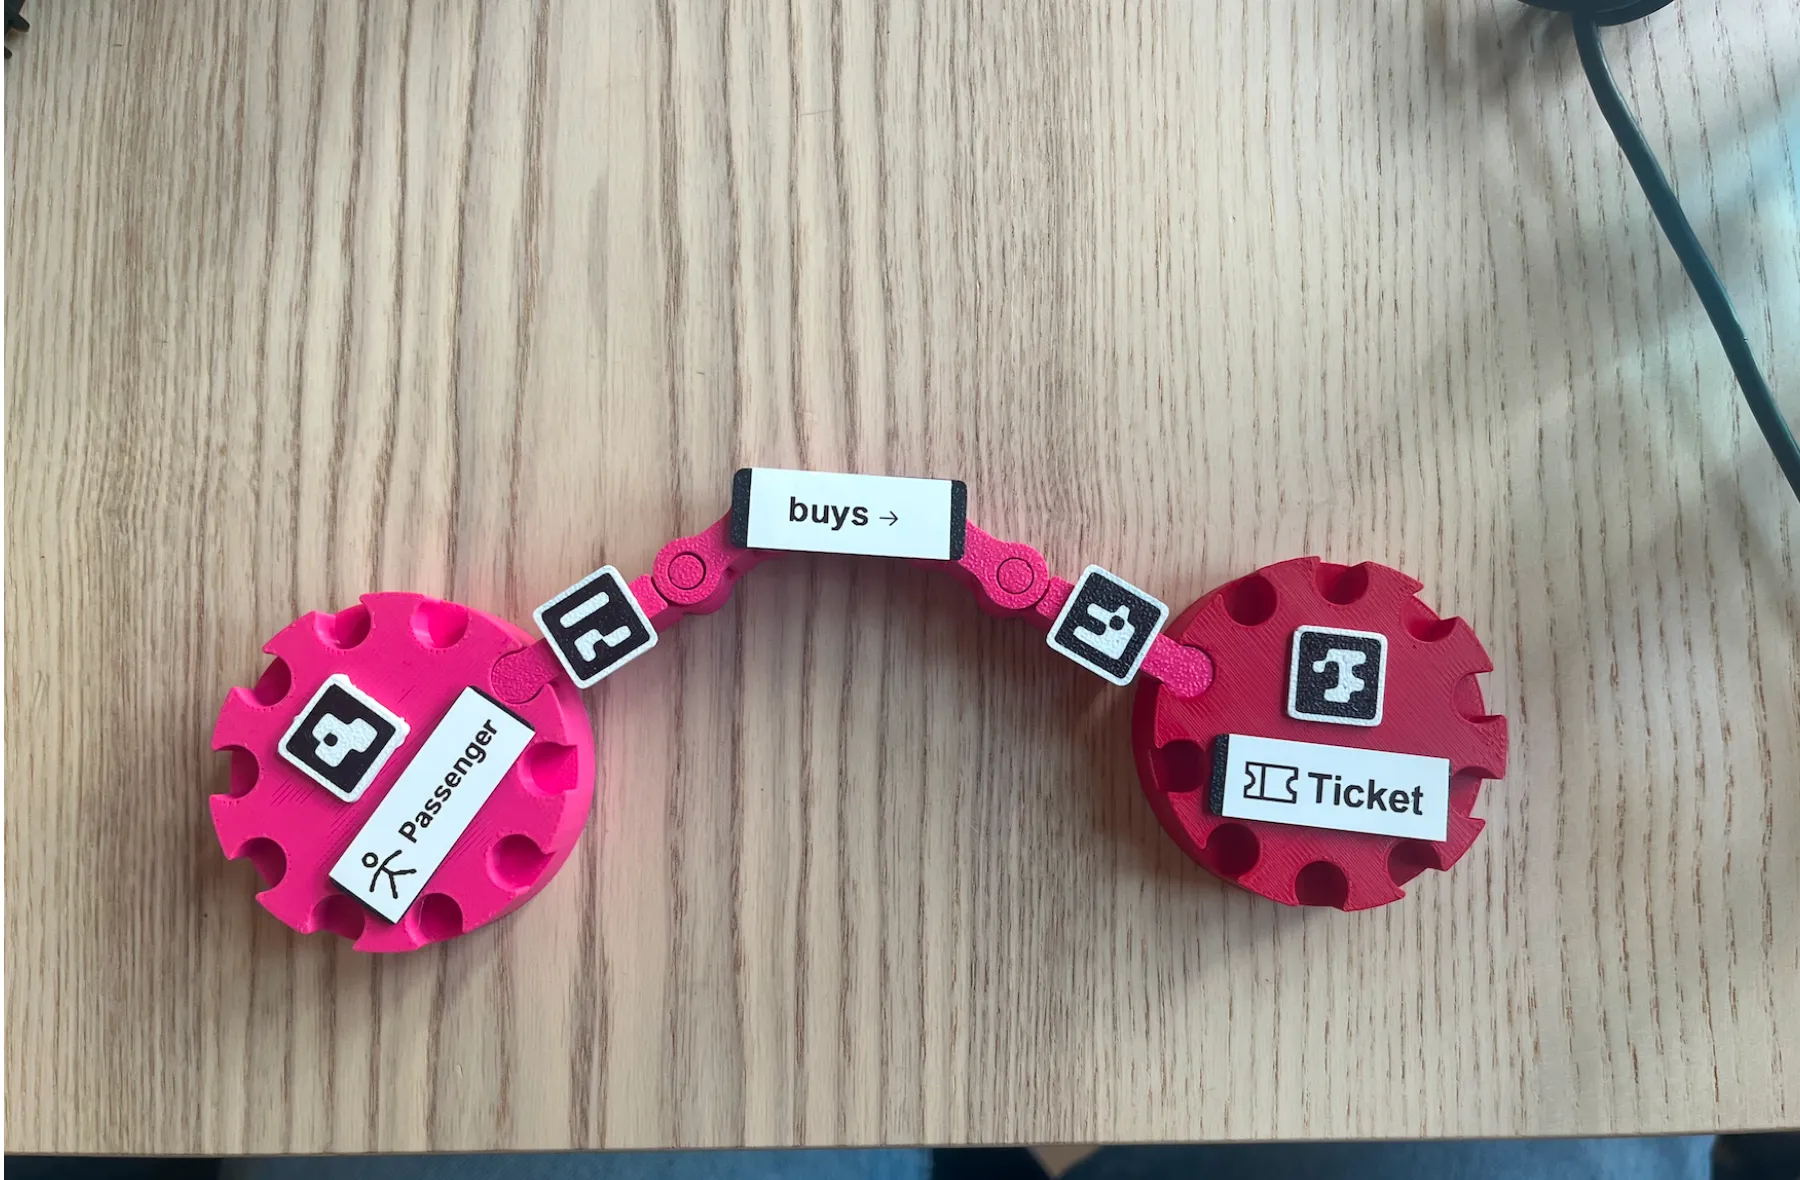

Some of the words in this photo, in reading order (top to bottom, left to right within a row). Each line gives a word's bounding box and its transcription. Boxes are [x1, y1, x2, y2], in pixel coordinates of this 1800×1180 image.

[789, 496, 869, 531] buys
[398, 719, 498, 844] Passenger
[1307, 771, 1424, 816] Ticket
